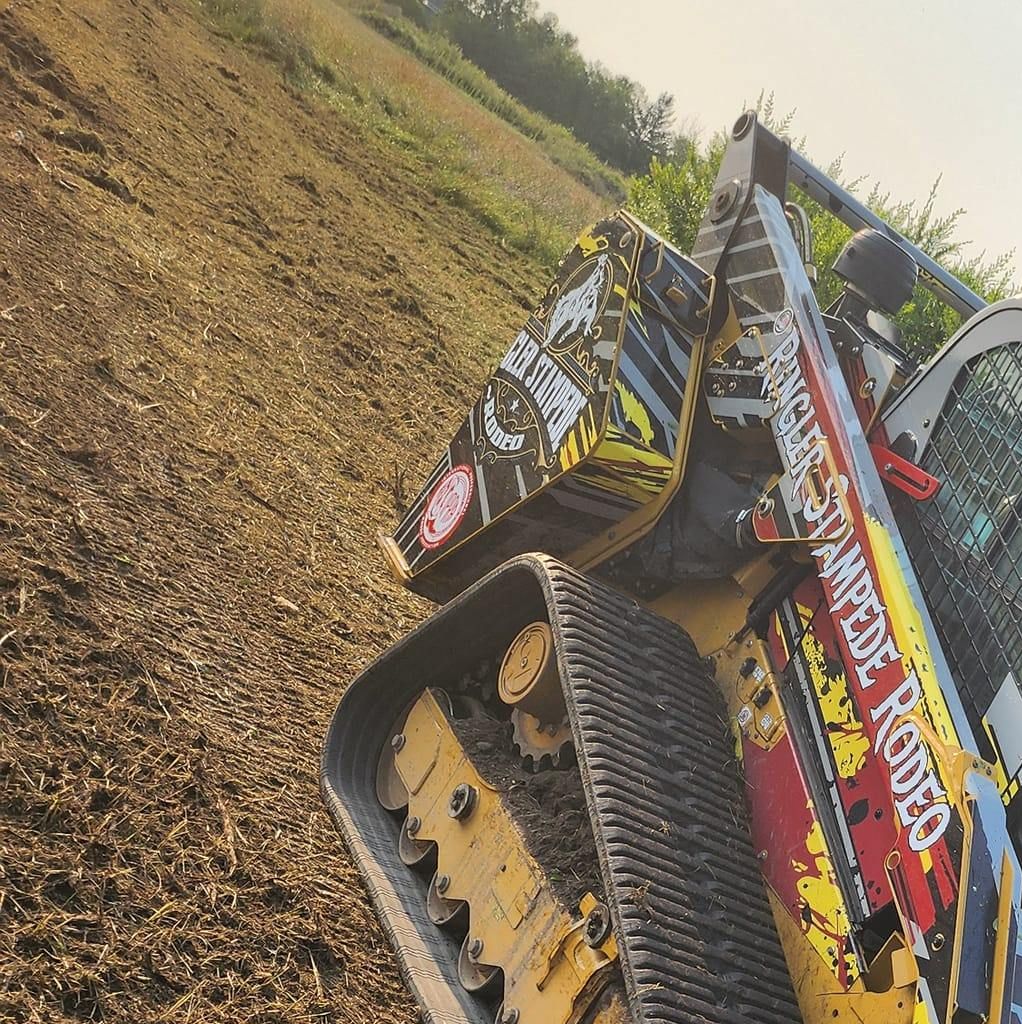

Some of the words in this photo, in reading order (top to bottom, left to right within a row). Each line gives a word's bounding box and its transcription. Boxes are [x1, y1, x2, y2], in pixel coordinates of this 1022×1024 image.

[484, 397, 525, 450] RODEO
[525, 353, 588, 453] STAMPEDE
[803, 473, 904, 689] STAMPEDE
[871, 671, 952, 854] RODEO
